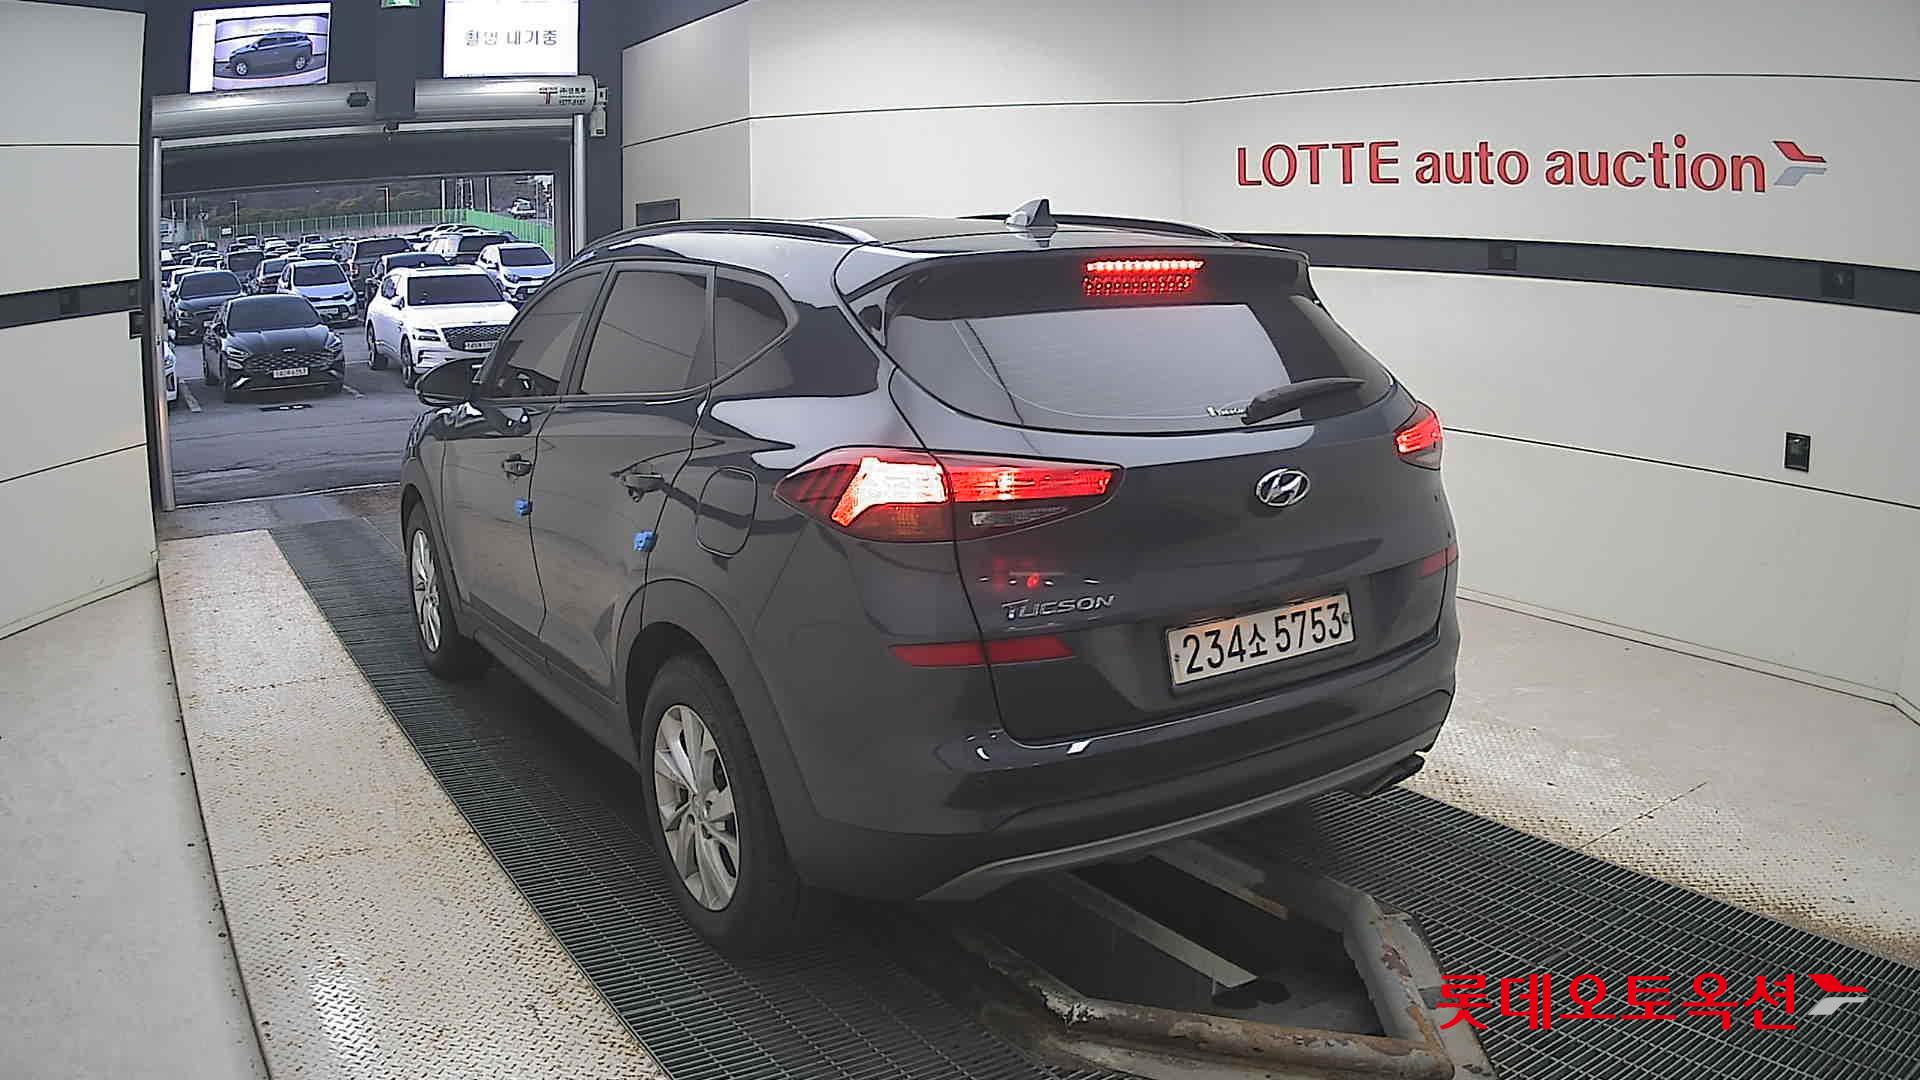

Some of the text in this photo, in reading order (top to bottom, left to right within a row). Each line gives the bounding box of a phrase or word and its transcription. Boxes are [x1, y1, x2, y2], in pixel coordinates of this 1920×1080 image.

[1236, 134, 1769, 192] LOTTE auto auction
[1002, 594, 1115, 621] TUCSON
